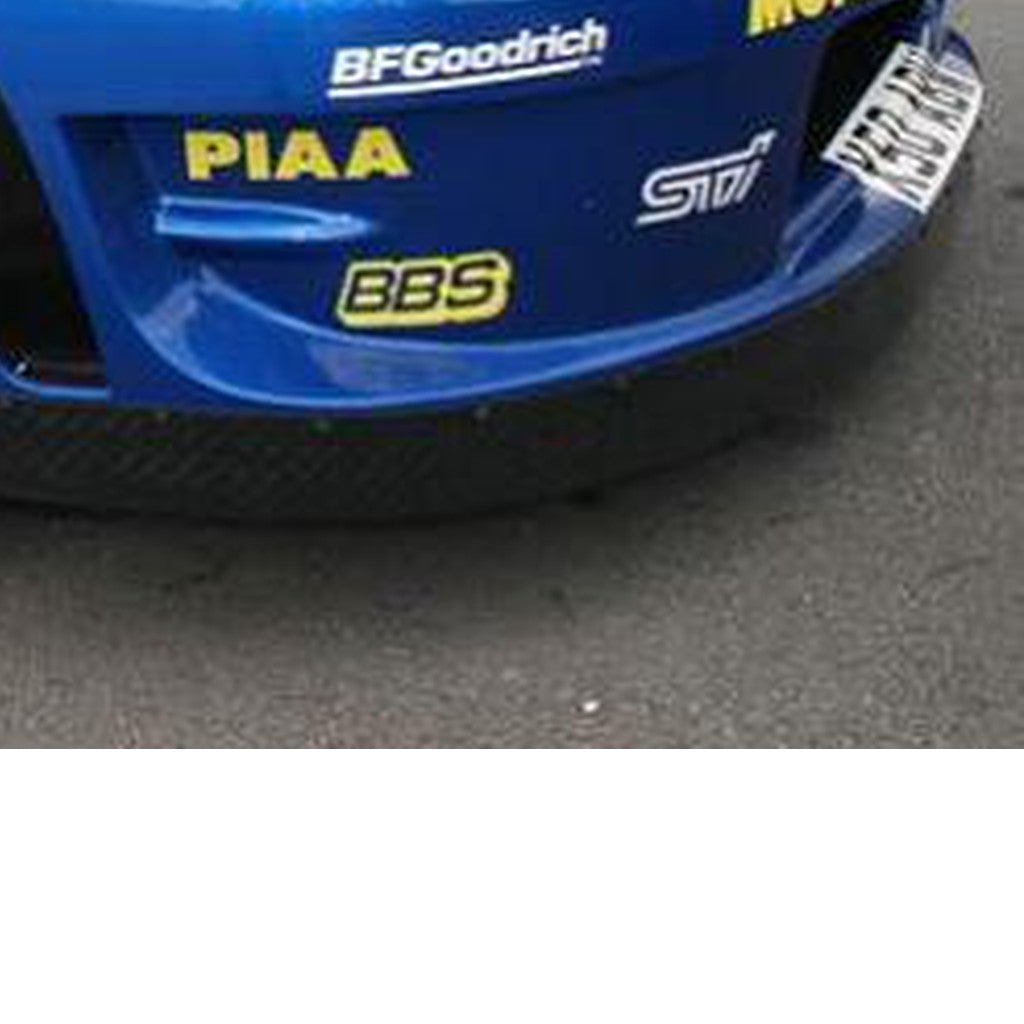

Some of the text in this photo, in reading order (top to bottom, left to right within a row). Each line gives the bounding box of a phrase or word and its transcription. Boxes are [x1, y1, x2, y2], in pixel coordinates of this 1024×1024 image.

[330, 18, 608, 87] BFGoodrich
[184, 127, 411, 181] PIAA
[341, 257, 502, 317] BBS
